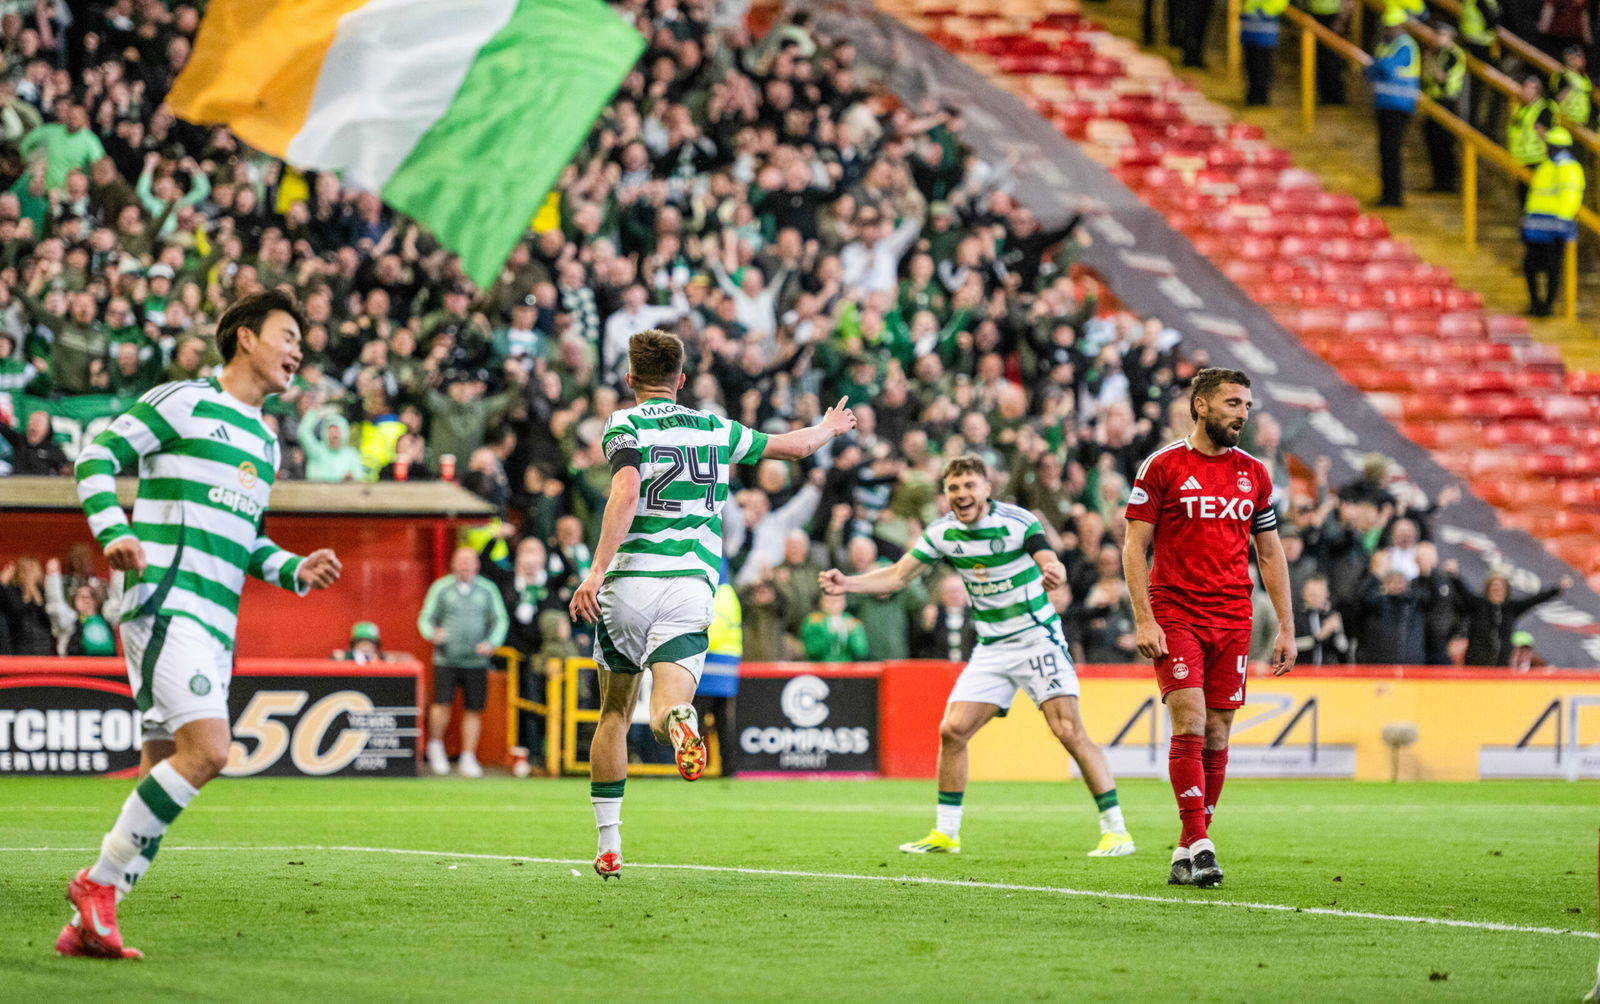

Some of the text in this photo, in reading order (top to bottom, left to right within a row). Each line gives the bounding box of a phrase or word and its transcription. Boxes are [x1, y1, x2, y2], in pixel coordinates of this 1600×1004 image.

[656, 415, 699, 430] KENNY
[646, 445, 718, 512] 24
[1179, 496, 1254, 522] TEXO
[1029, 653, 1058, 678] 49
[1236, 655, 1248, 684] 4
[0, 709, 142, 751] TCHEO
[221, 690, 376, 776] 50
[740, 726, 870, 754] COMPASS
